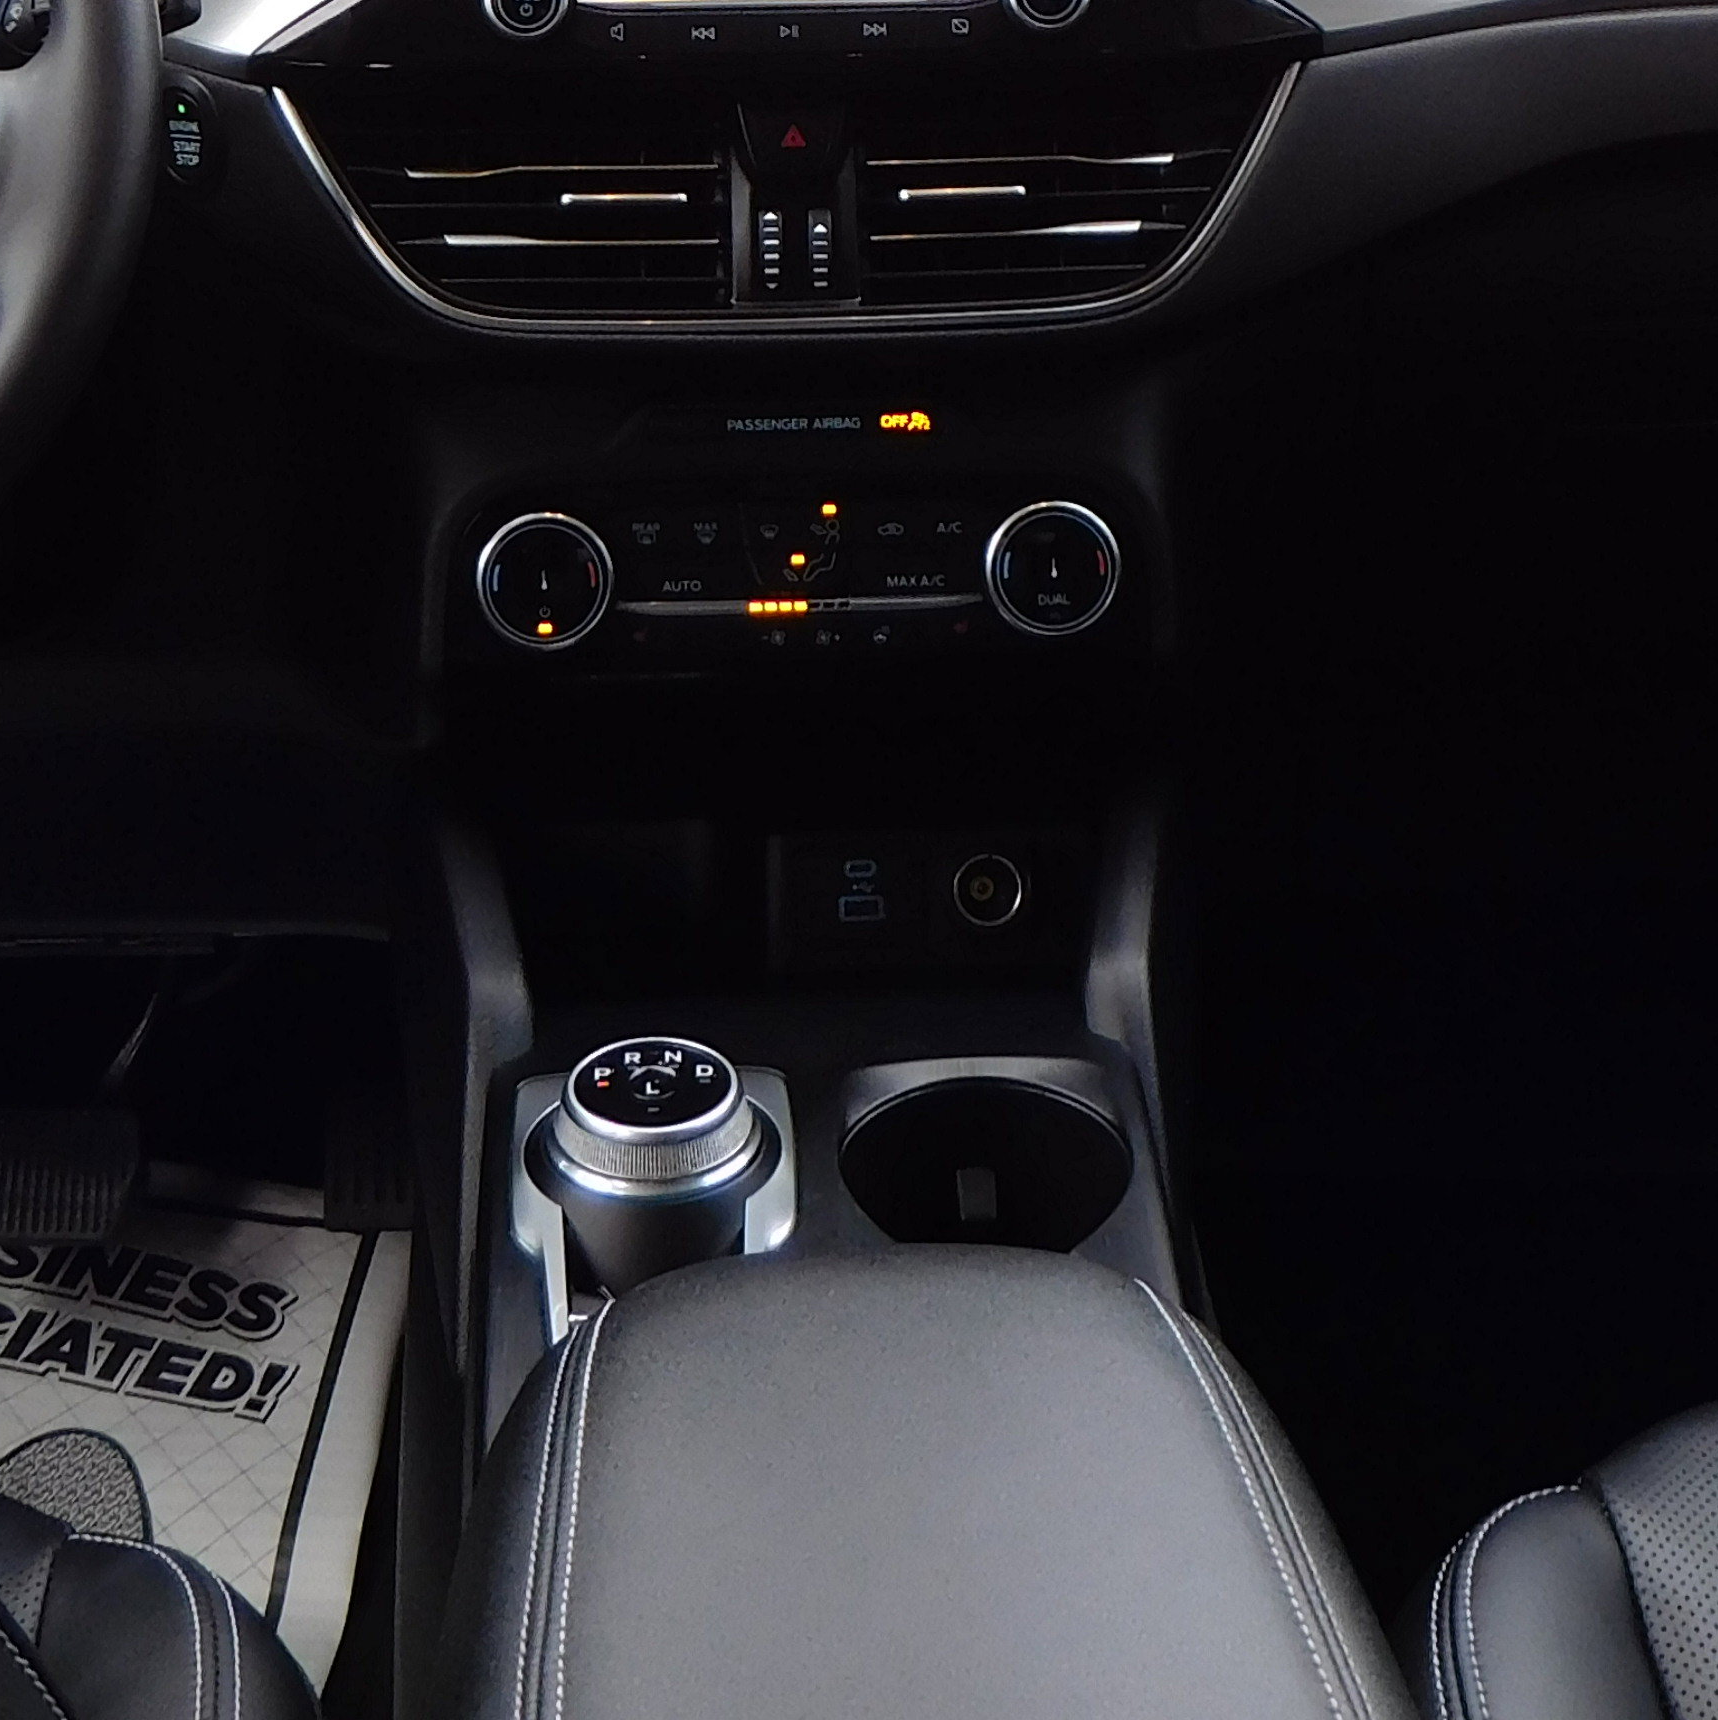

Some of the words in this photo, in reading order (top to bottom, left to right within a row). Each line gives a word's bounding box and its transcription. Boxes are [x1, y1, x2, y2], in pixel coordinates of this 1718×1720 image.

[726, 418, 808, 433] PASSENGER
[812, 416, 862, 431] AIRBAG
[879, 414, 909, 429] OFF
[936, 521, 963, 534] A/C
[662, 579, 702, 592] AUTO
[886, 576, 917, 588] MAX
[919, 574, 946, 587] A/C
[1037, 593, 1071, 607] DUAL
[594, 1067, 612, 1080] P
[624, 1051, 642, 1064] R
[663, 1050, 682, 1063] N
[695, 1064, 714, 1078] D
[645, 1080, 660, 1095] L
